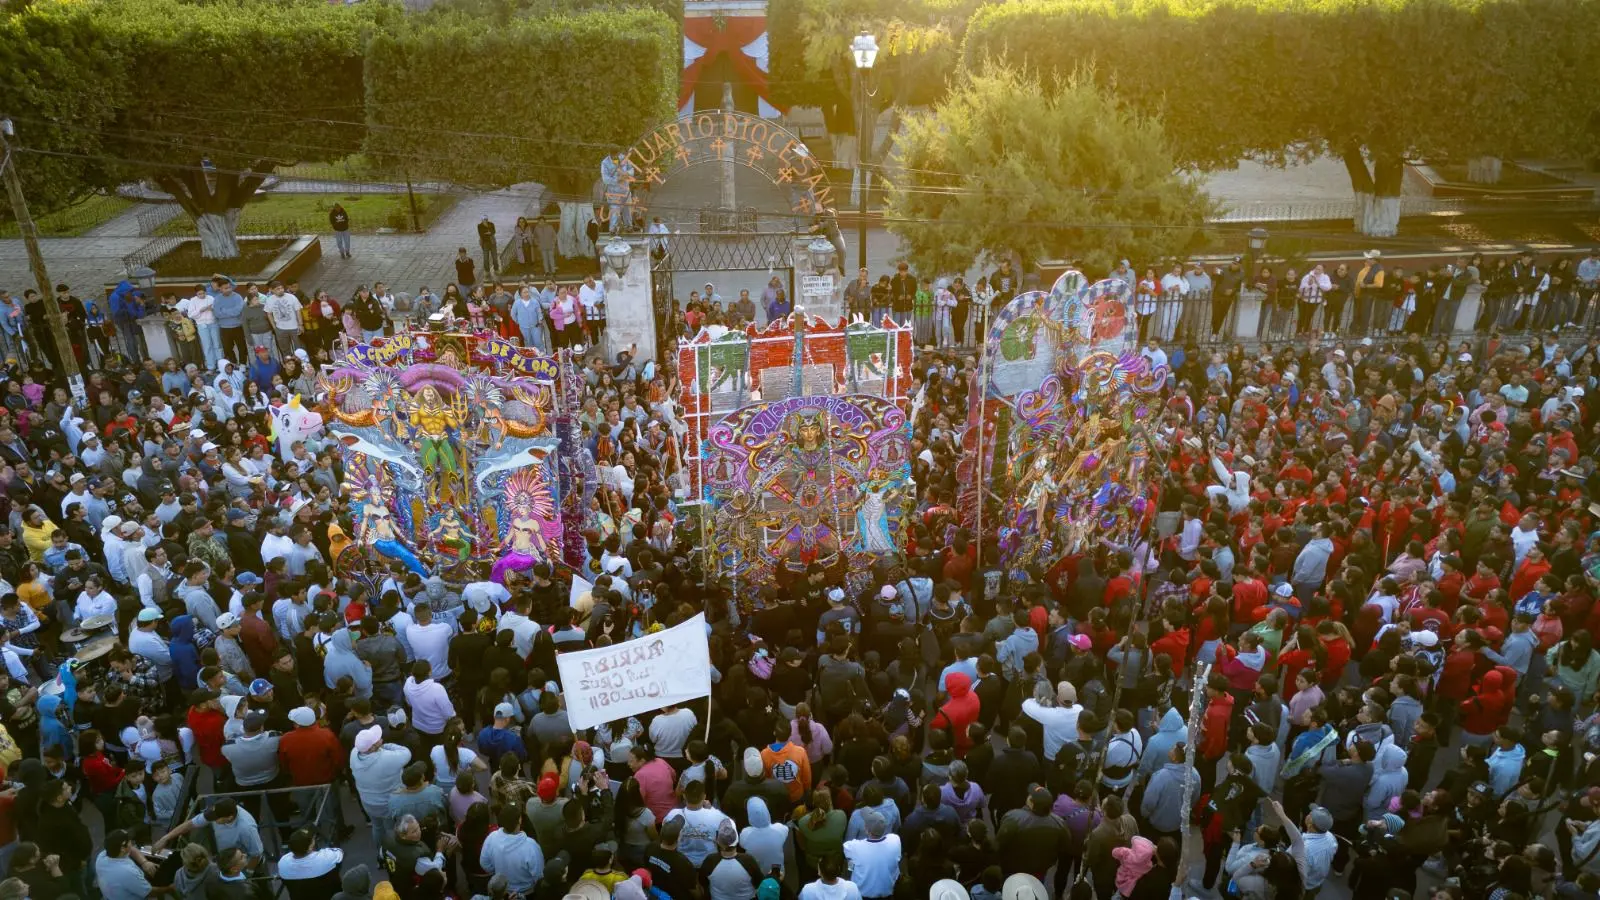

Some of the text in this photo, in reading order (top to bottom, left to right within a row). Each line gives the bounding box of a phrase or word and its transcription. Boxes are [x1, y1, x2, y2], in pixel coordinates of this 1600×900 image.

[600, 114, 835, 222] TUARIO DIOCESAN
[490, 341, 558, 378] DE EL ORO
